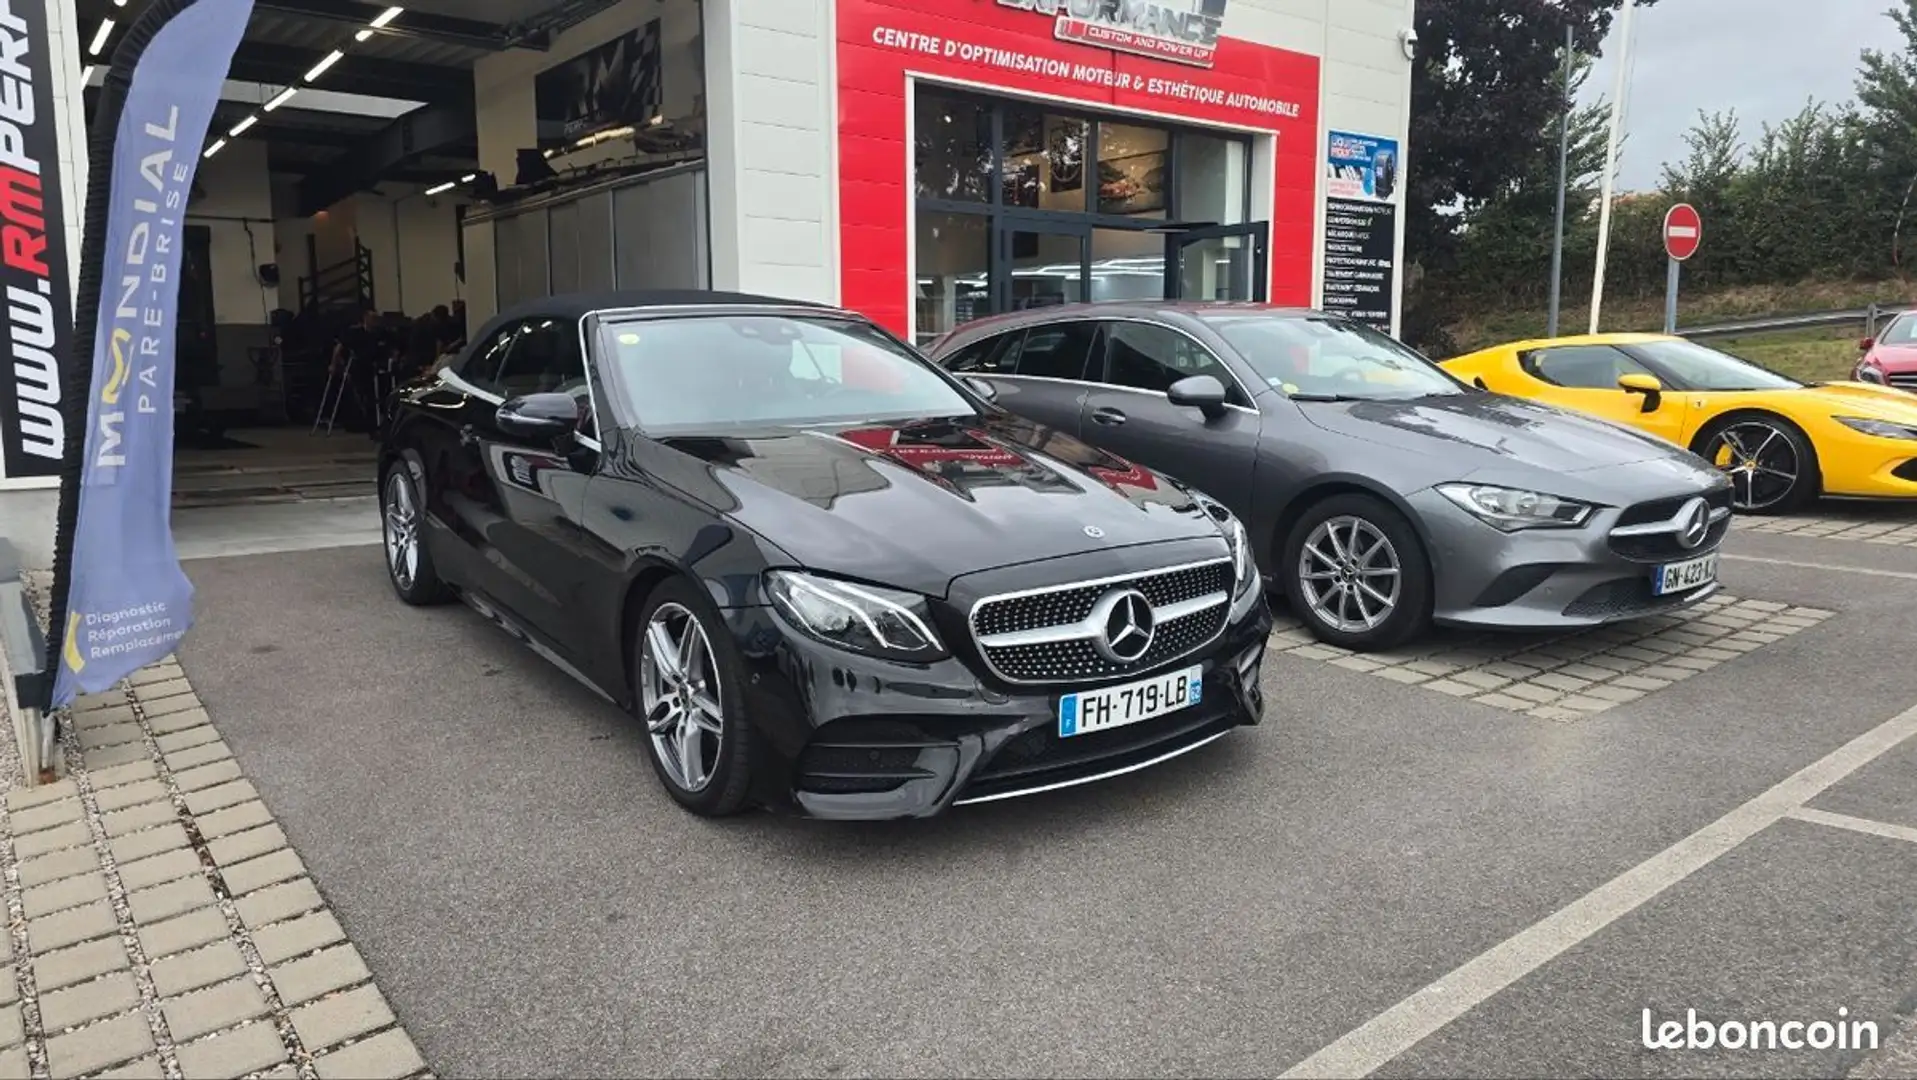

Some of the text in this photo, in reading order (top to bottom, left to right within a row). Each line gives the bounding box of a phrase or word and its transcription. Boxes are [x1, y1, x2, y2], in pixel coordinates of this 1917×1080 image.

[1089, 26, 1209, 59] CUSTOM AND POWER UP
[872, 26, 1300, 117] CENTRE D'OPTIMISATION MOTEUR & ESTHÉTIQUE AUTOMOBILE
[138, 162, 187, 413] PARE-BRISE
[85, 601, 167, 626] Diagnostic
[87, 617, 171, 643] Réparation
[1082, 676, 1187, 728] FH-719-LB
